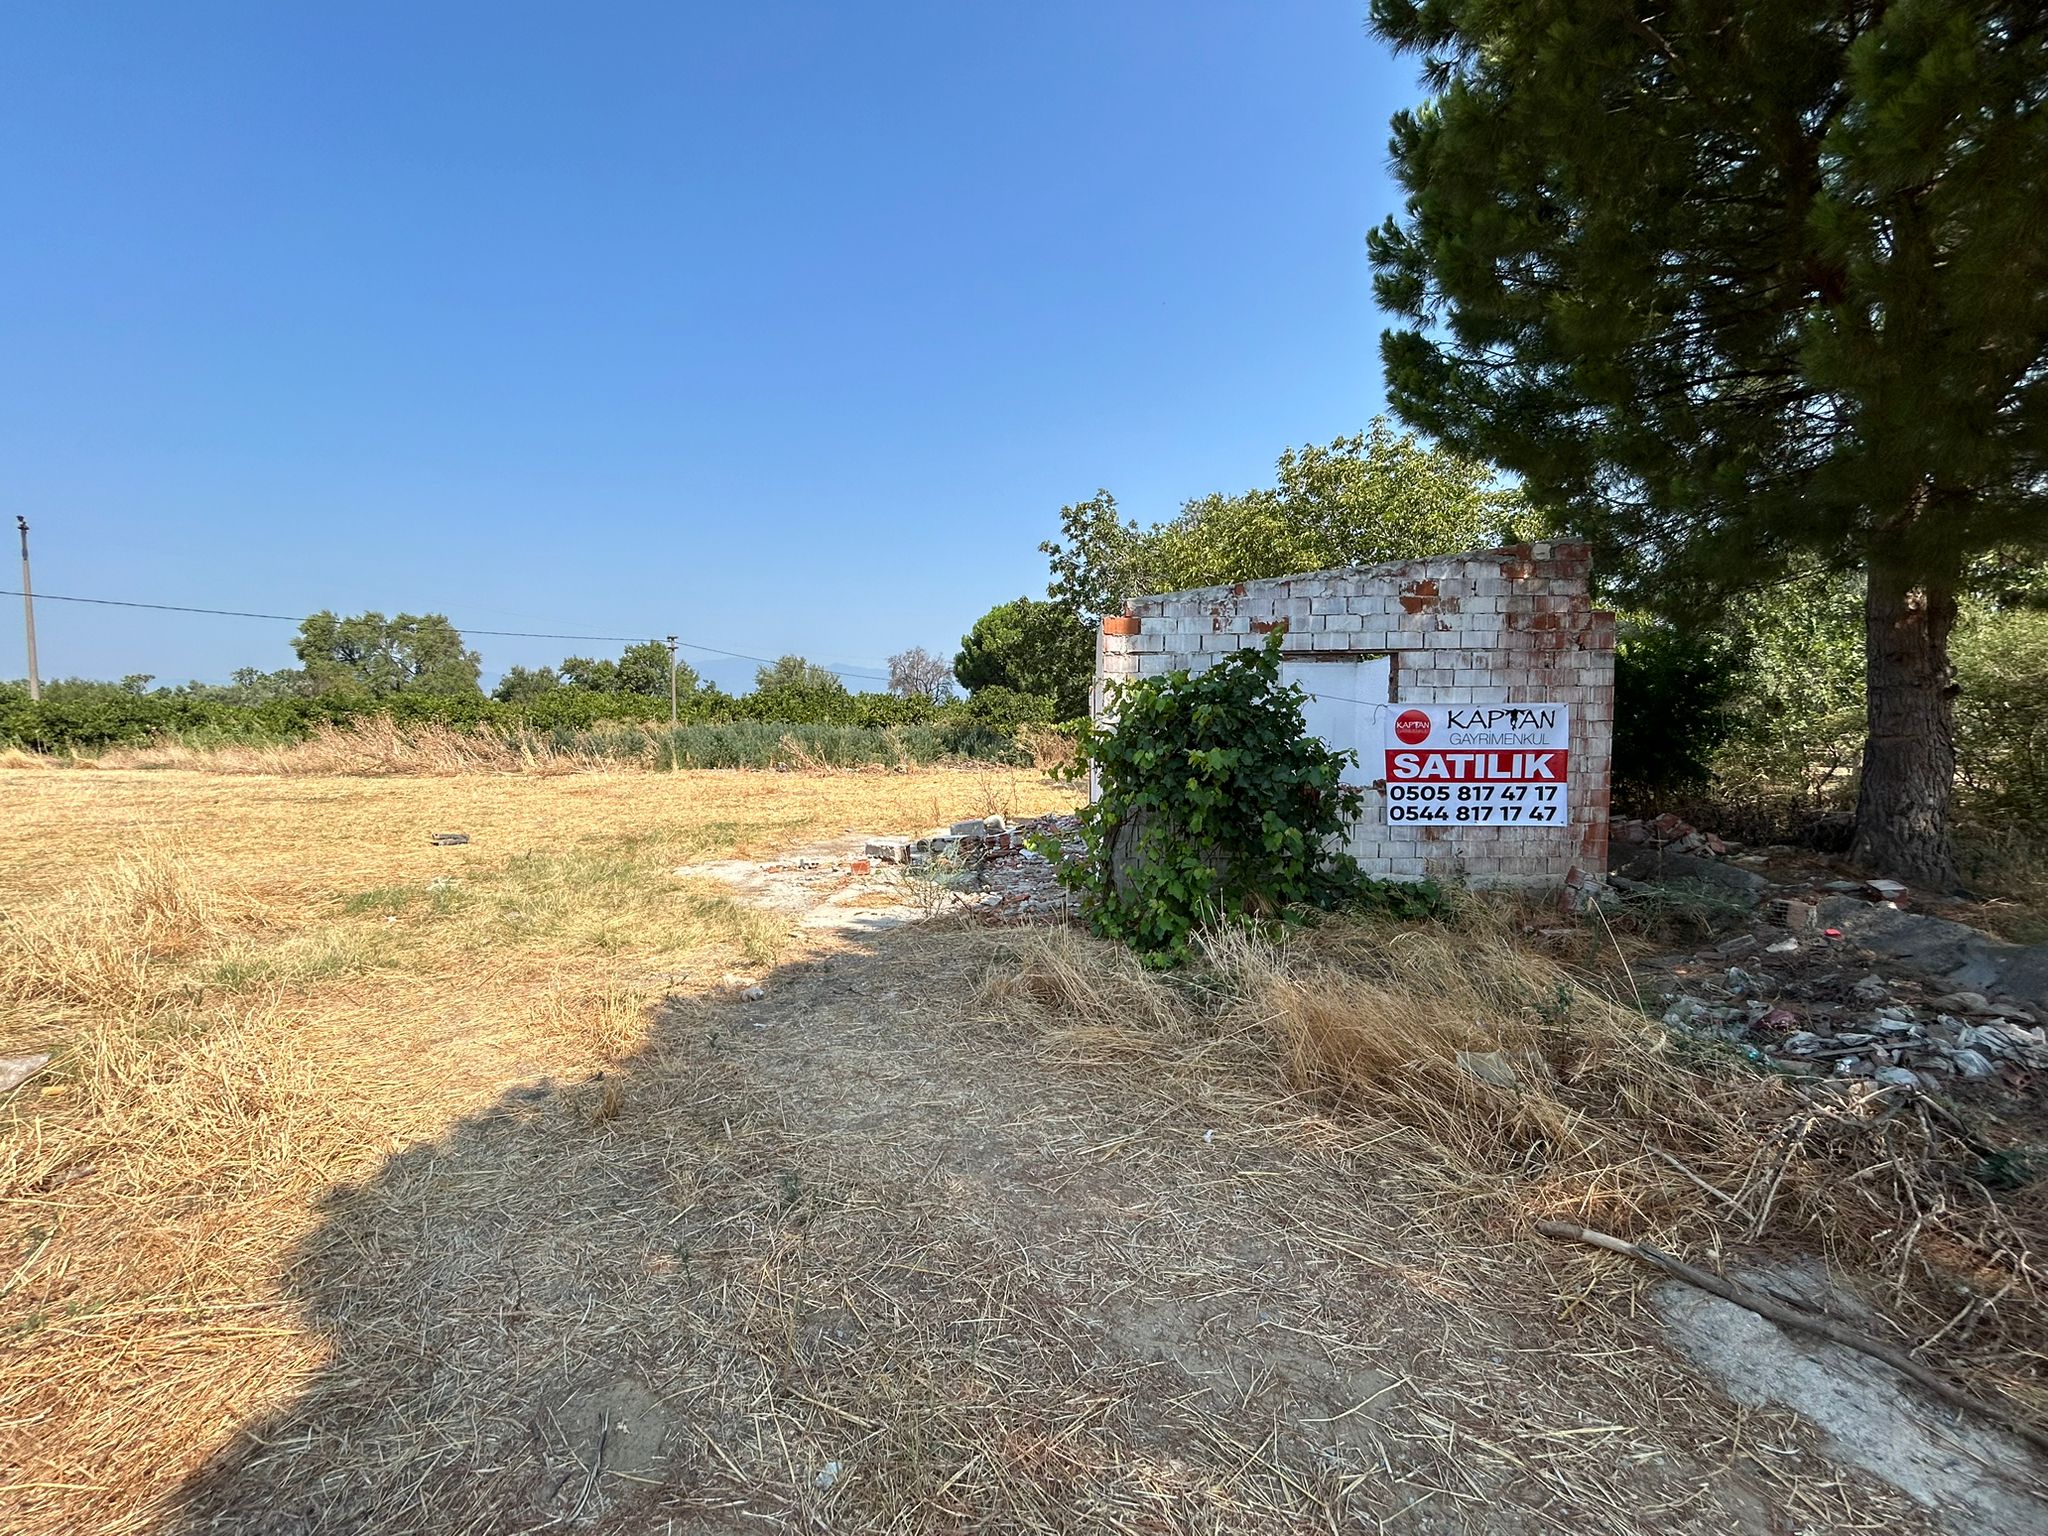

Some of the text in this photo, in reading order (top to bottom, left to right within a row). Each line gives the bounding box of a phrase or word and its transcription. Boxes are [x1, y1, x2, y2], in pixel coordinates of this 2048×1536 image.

[1447, 708, 1555, 731] KAPTAN
[1393, 753, 1555, 779] SATILIK
[1390, 786, 1557, 801] 0505 817 47 17
[1390, 806, 1557, 821] 0544 817 17 47
